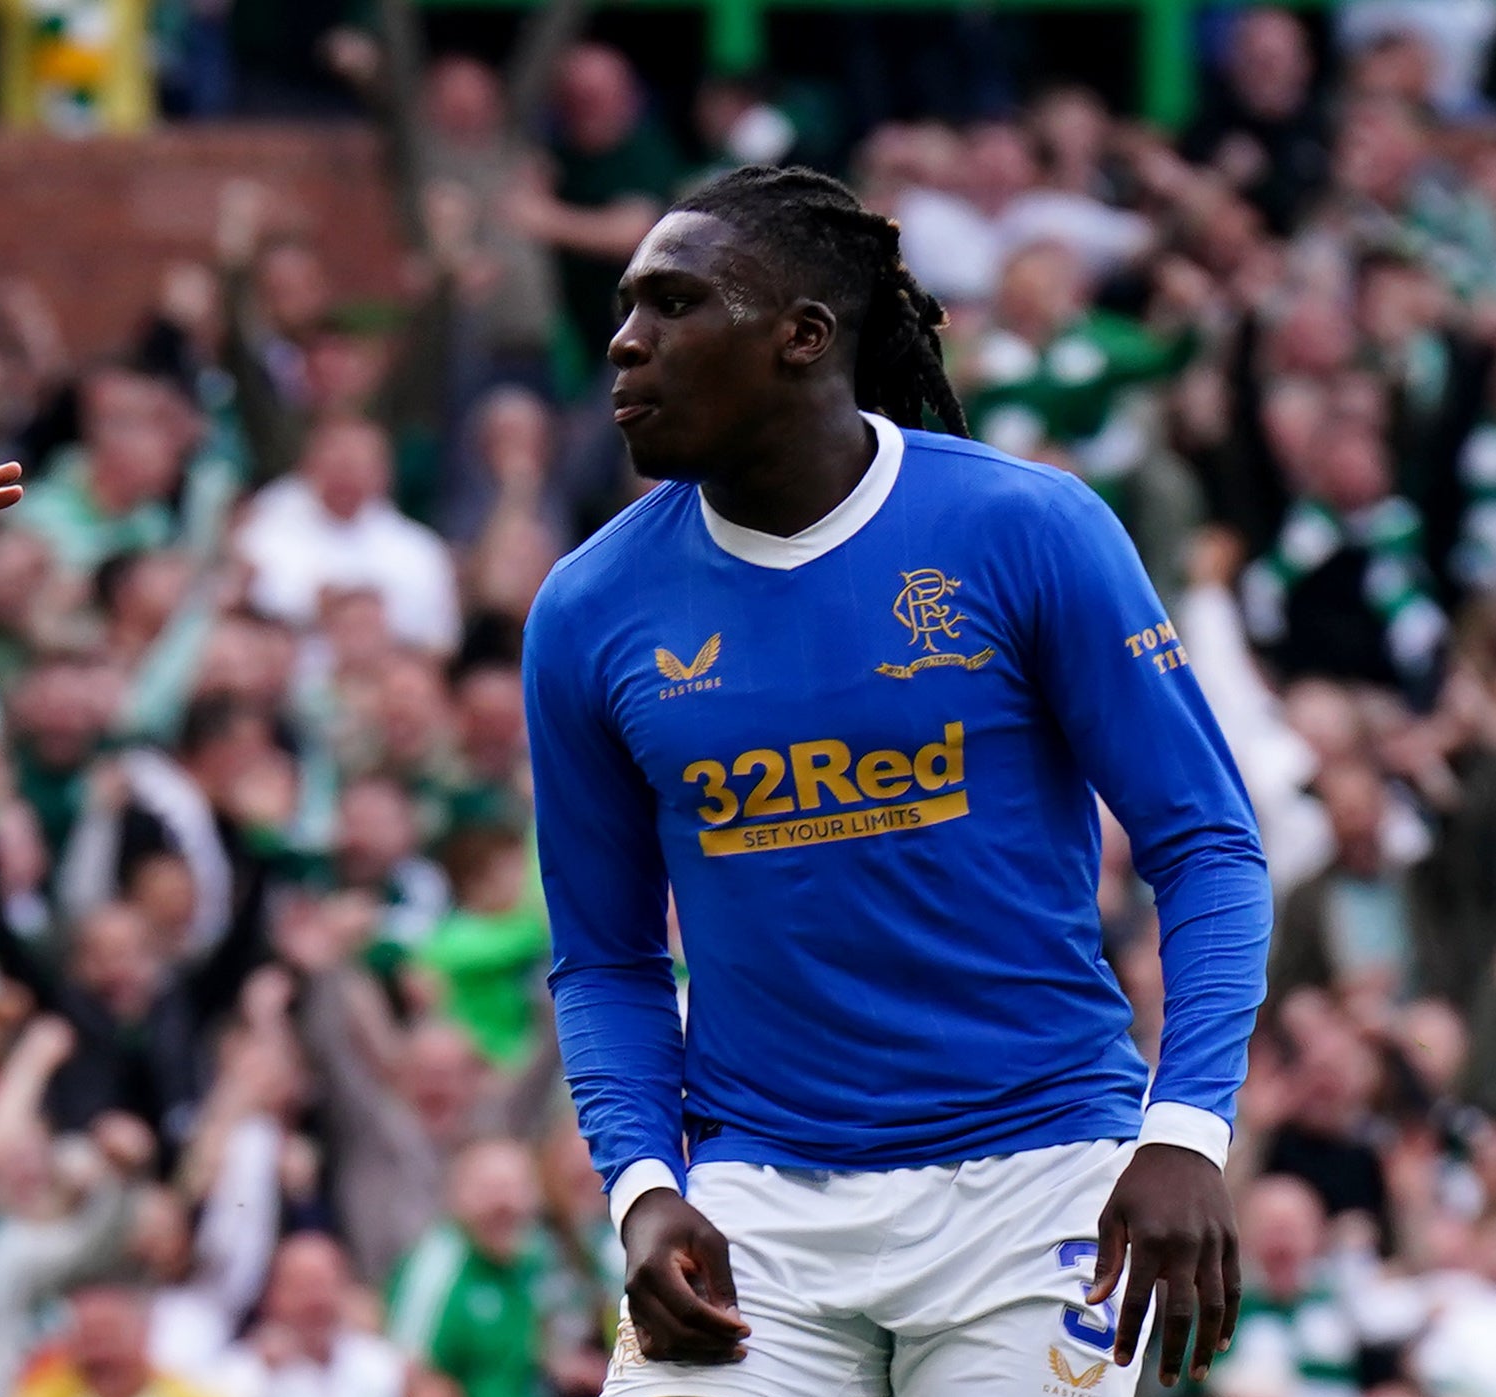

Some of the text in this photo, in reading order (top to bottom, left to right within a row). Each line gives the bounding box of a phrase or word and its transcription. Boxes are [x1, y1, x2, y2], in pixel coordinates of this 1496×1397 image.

[682, 722, 965, 826] 32Red
[743, 807, 922, 849] SET YOUR LIMITS
